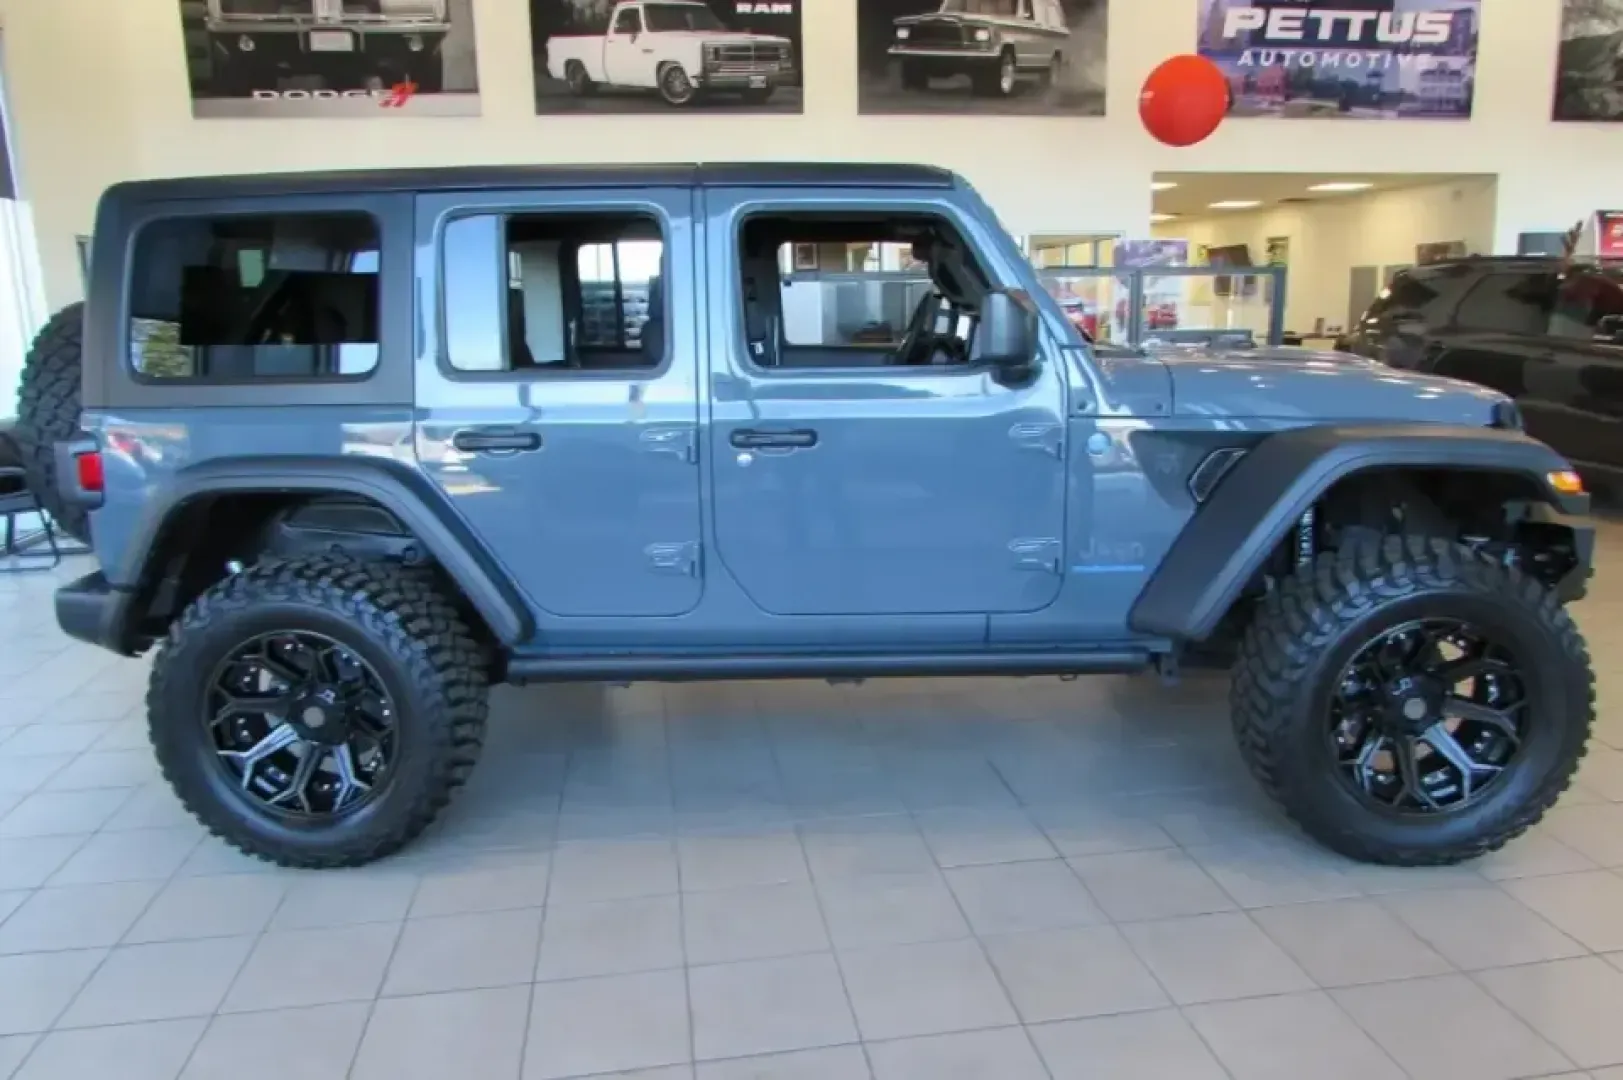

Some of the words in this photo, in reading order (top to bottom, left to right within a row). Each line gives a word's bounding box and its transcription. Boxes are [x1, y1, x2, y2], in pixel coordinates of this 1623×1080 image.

[736, 3, 792, 14] RAM
[1222, 7, 1453, 43] PETTUS
[1237, 51, 1432, 70] AUTOMOTIVE
[252, 89, 394, 100] DODGE
